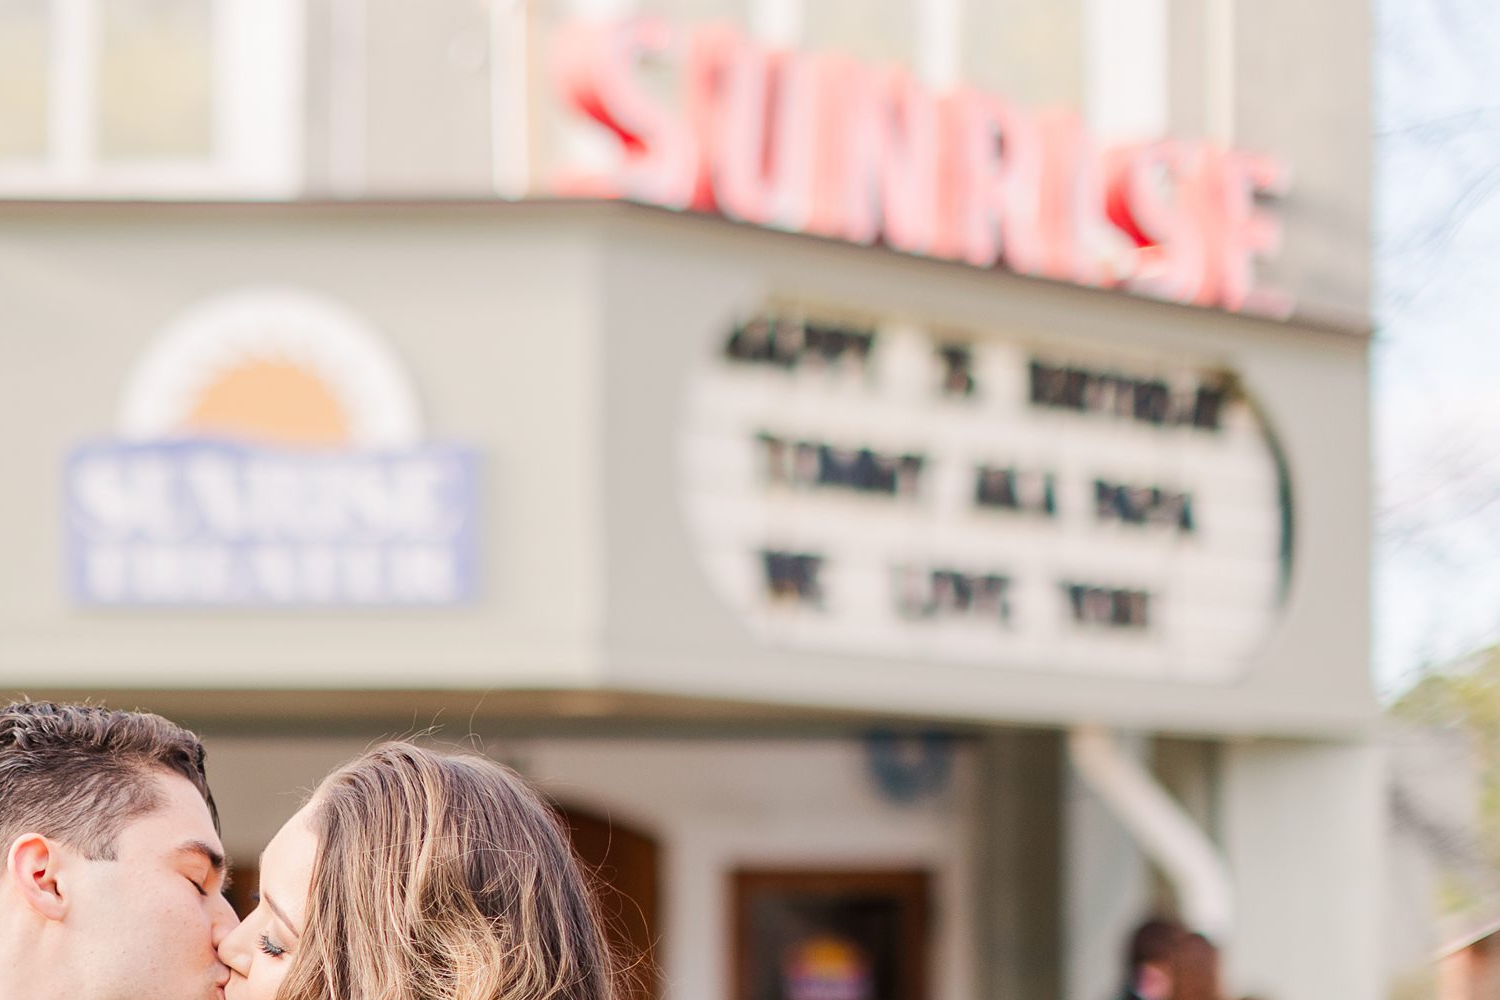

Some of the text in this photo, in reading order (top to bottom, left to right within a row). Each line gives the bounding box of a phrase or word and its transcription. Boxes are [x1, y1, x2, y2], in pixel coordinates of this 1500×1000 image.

[552, 14, 1294, 316] SUNRISE
[718, 310, 878, 384] HAPPY
[1024, 352, 1246, 432] BIRTHDAY
[72, 448, 455, 536] SUNRISE
[756, 430, 1196, 534] TOMMY AKA PAPA
[84, 542, 460, 604] THEATER
[756, 546, 1156, 632] WE LOVE YOU
